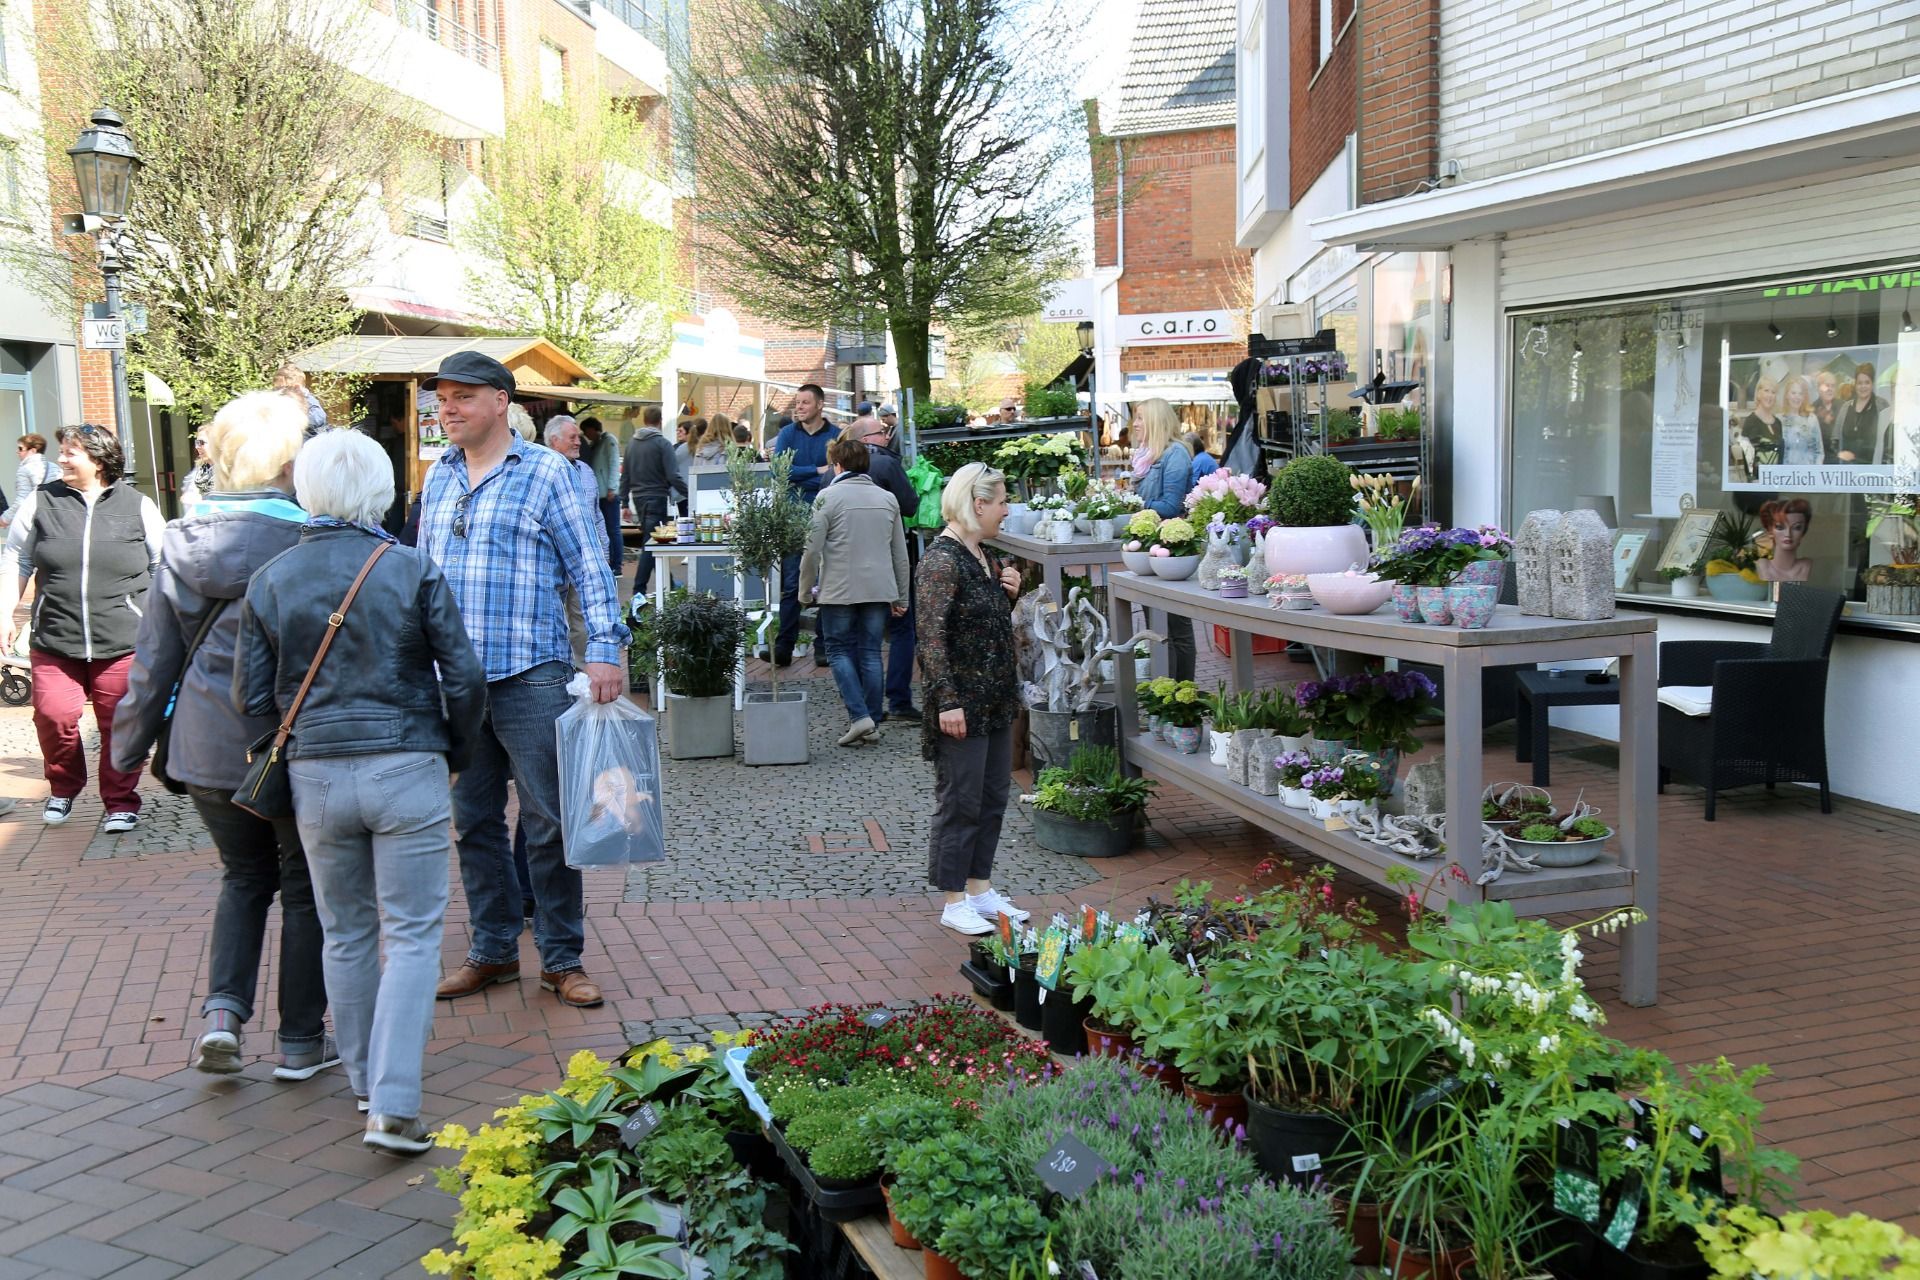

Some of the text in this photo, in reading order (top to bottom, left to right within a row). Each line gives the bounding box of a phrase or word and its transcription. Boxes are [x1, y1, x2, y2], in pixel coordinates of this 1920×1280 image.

[1050, 308, 1084, 317] c.a.r.o
[96, 323, 120, 337] WC
[1141, 318, 1217, 335] c.a.r.o
[1761, 471, 1816, 486] Herzlich
